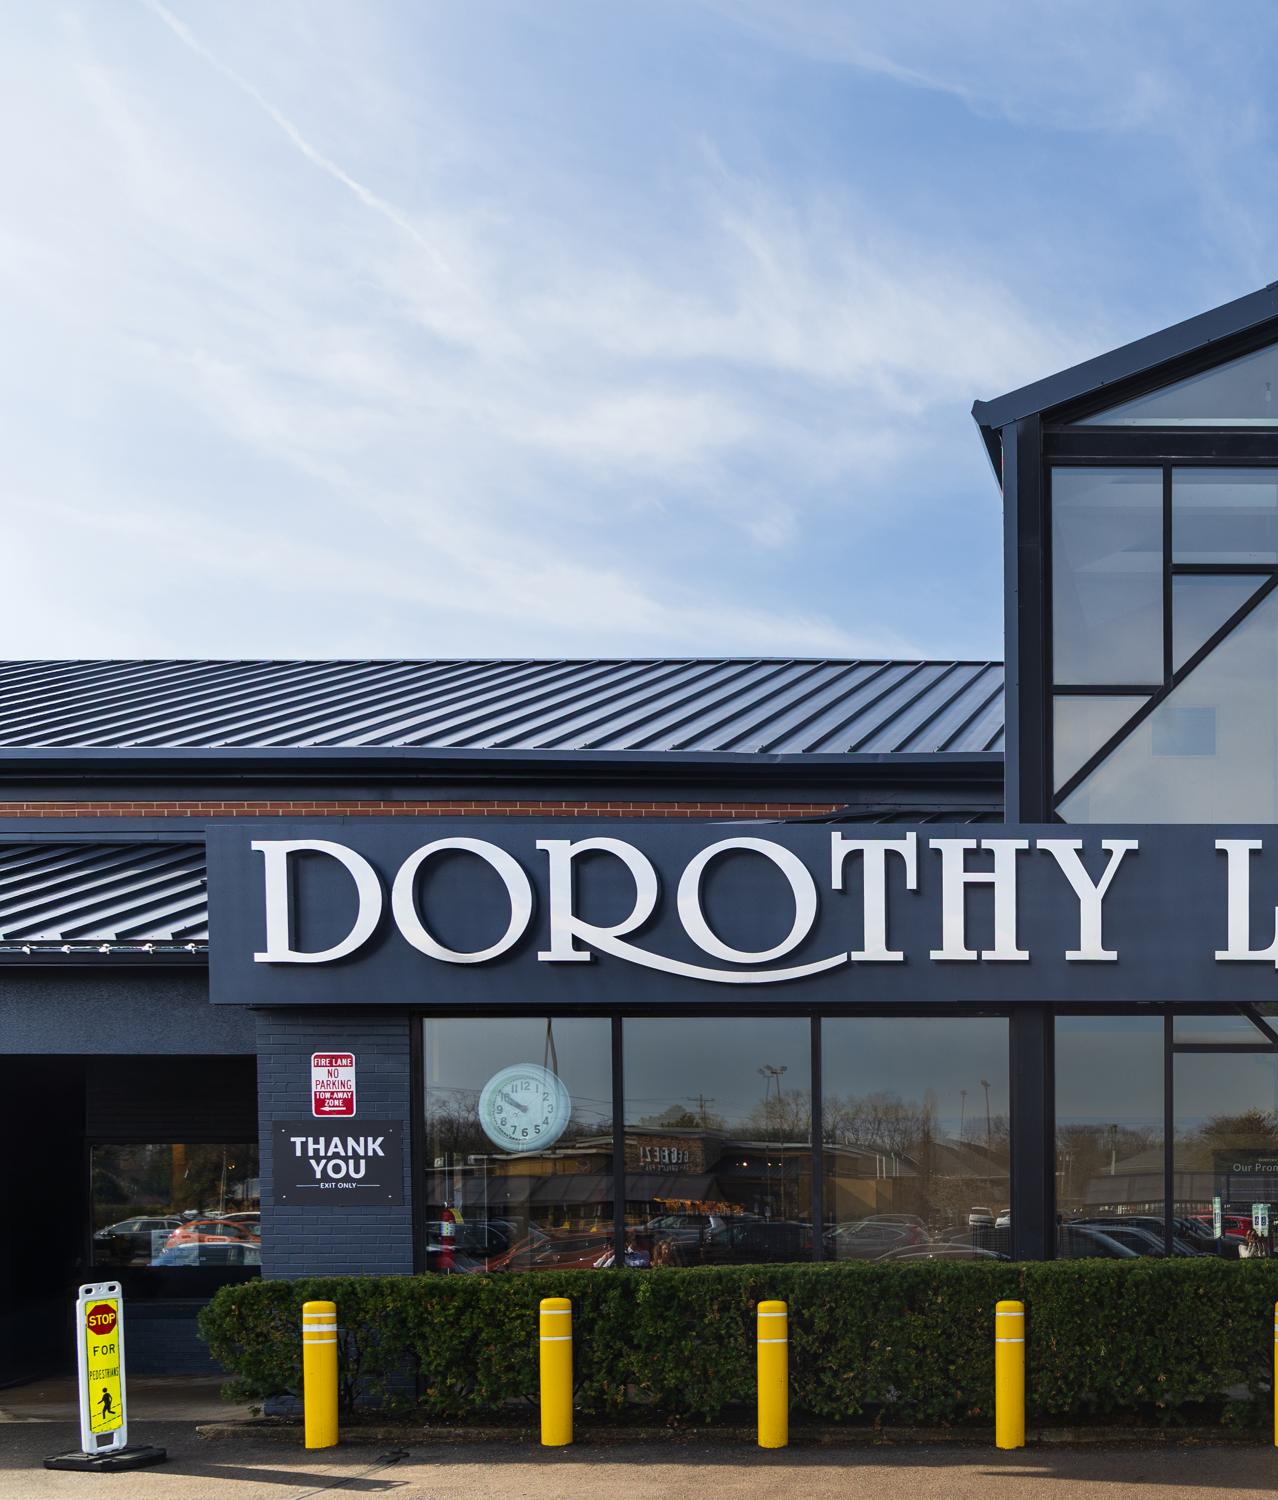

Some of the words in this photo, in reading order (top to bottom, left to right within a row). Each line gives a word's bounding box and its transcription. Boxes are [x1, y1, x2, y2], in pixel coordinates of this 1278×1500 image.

[251, 831, 1138, 983] DOROTHY
[314, 1058, 330, 1067] FIRE
[332, 1058, 352, 1067] LANE
[327, 1068, 339, 1079] NO
[315, 1079, 352, 1090] PARKING
[520, 1081, 530, 1091] 12
[316, 1091, 353, 1099] TOW-AWAY
[542, 1092, 550, 1102] 2
[324, 1099, 344, 1107] ZONE
[496, 1104, 504, 1115] 9
[547, 1104, 554, 1114] 3
[510, 1125, 517, 1135] 7
[521, 1127, 529, 1137] 6
[534, 1124, 541, 1134] 5
[290, 1136, 385, 1157] THANK
[309, 1158, 366, 1179] YOU
[1232, 1163, 1252, 1172] Our
[89, 1314, 115, 1326] STOP
[93, 1343, 116, 1357] FOR
[89, 1366, 119, 1381] PEDESTRIANS
